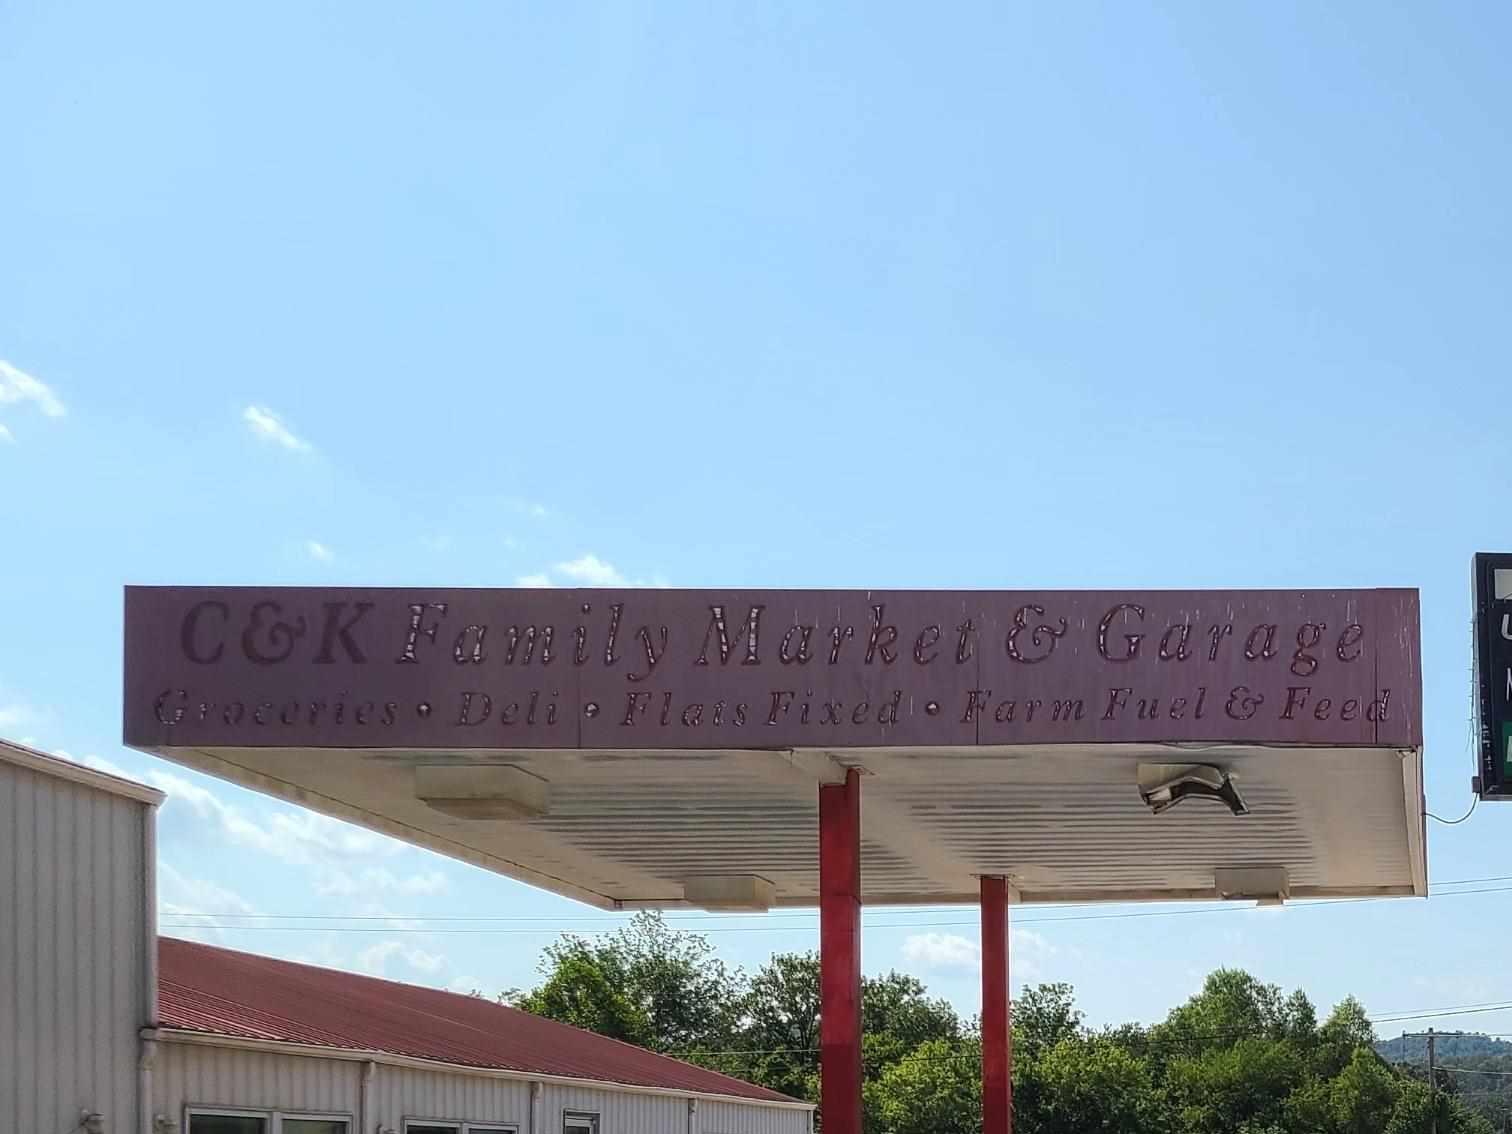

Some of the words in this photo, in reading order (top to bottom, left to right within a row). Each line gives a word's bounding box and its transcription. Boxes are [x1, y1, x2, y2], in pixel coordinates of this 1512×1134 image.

[395, 602, 669, 682] Family
[694, 603, 977, 666] Market
[1005, 603, 1068, 665] &
[1098, 602, 1364, 678] Garage
[153, 688, 398, 727] Groceries
[455, 688, 560, 727] Deli
[765, 687, 903, 727] Fixed
[959, 689, 1086, 724] Farm
[1100, 686, 1208, 721] Fuel
[1224, 685, 1265, 721] &
[1278, 686, 1392, 722] Feed
